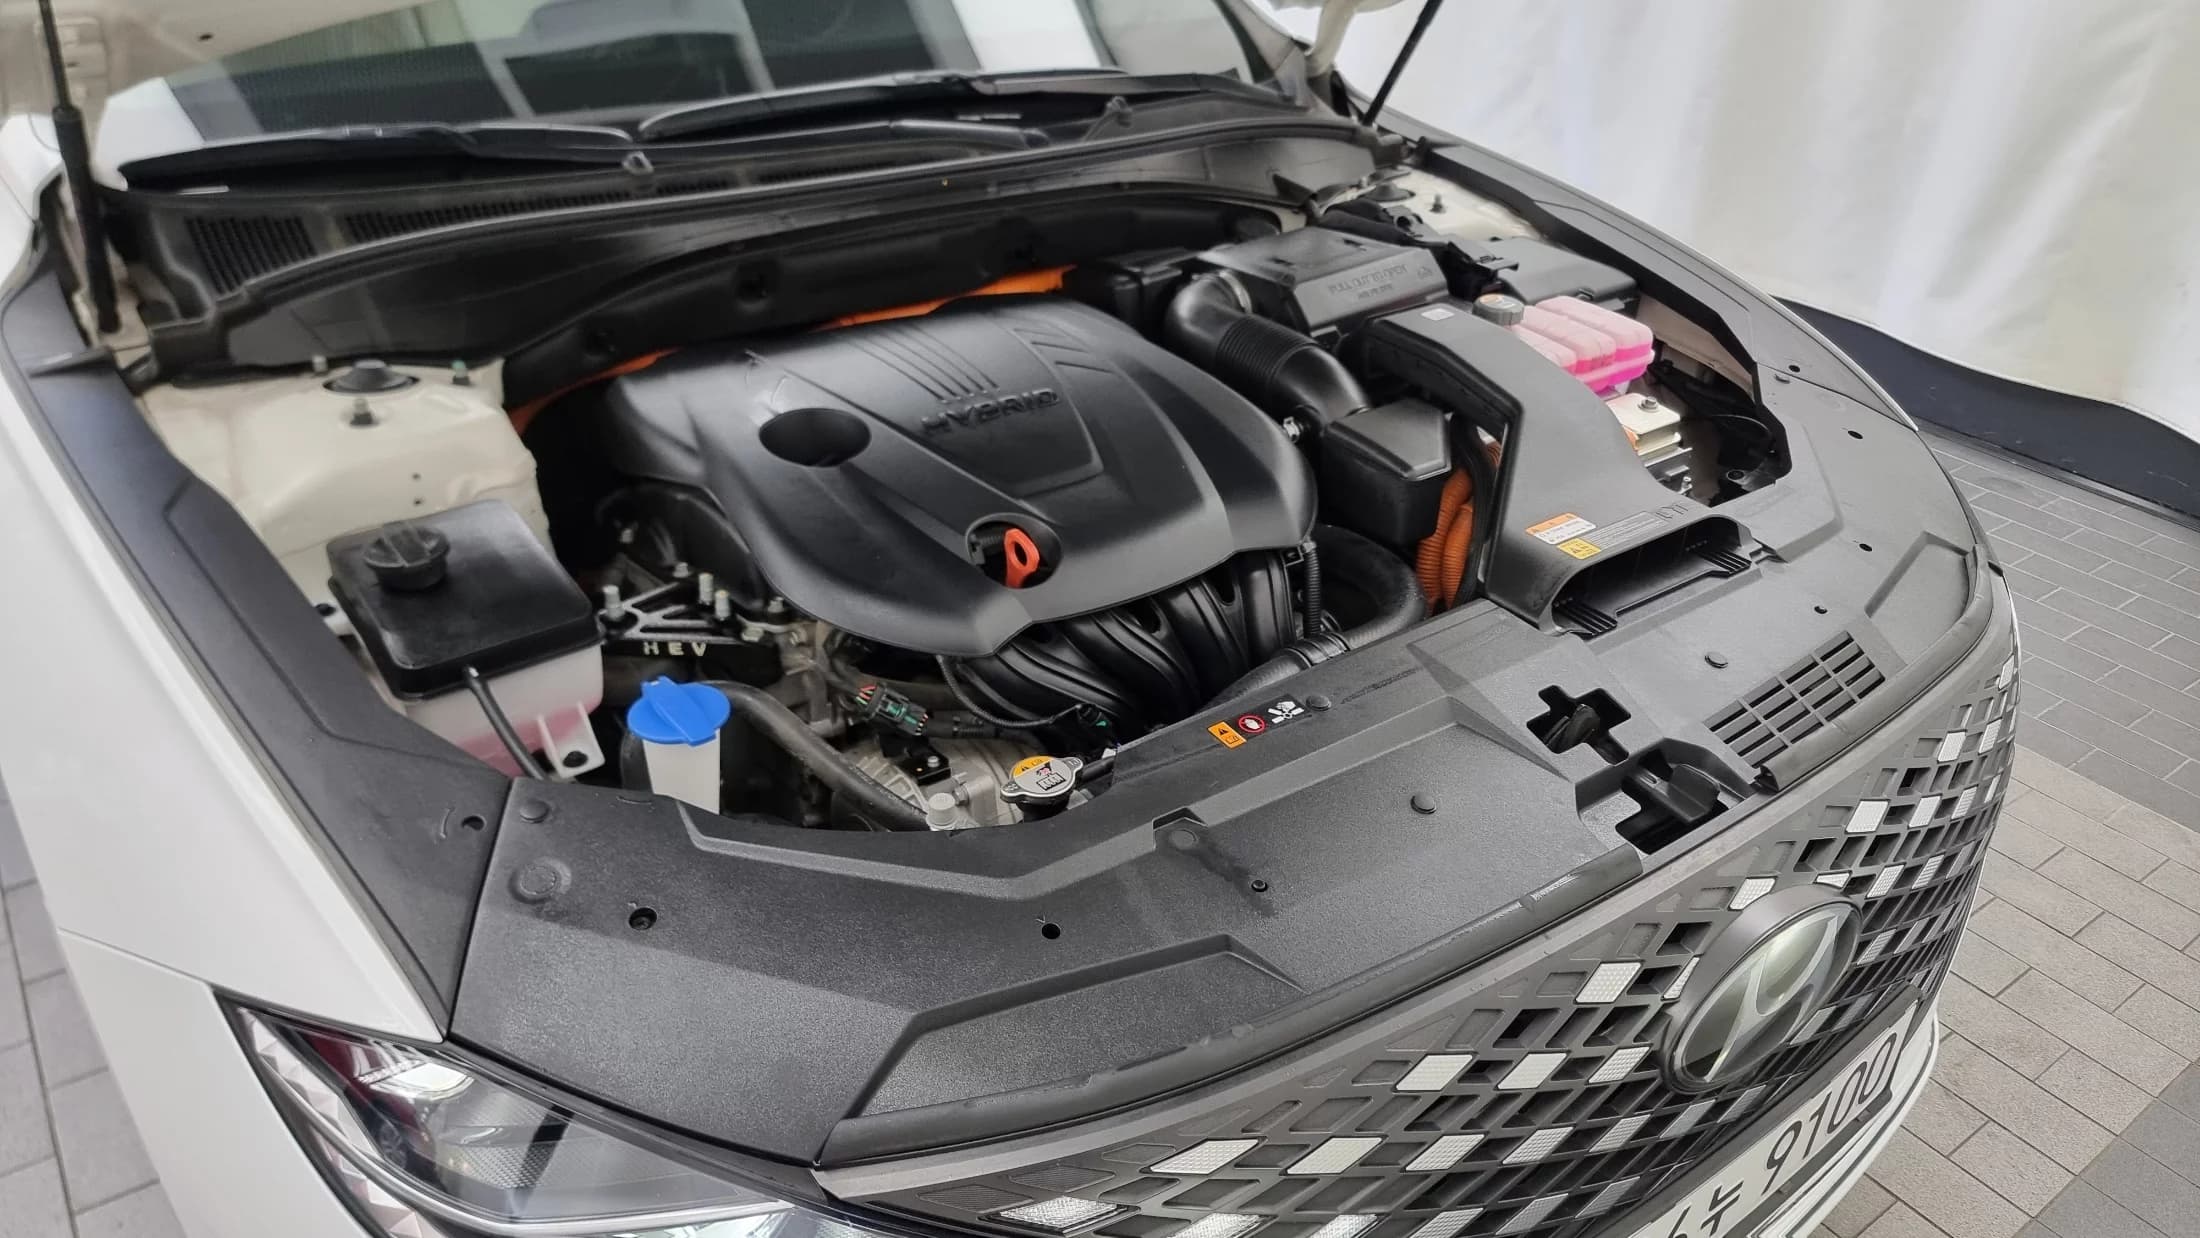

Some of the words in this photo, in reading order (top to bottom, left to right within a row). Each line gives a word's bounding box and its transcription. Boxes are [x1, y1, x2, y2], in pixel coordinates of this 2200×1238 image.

[921, 387, 1058, 434] HYBRID
[643, 641, 707, 656] HEV
[1761, 1031, 1898, 1196] 9100
